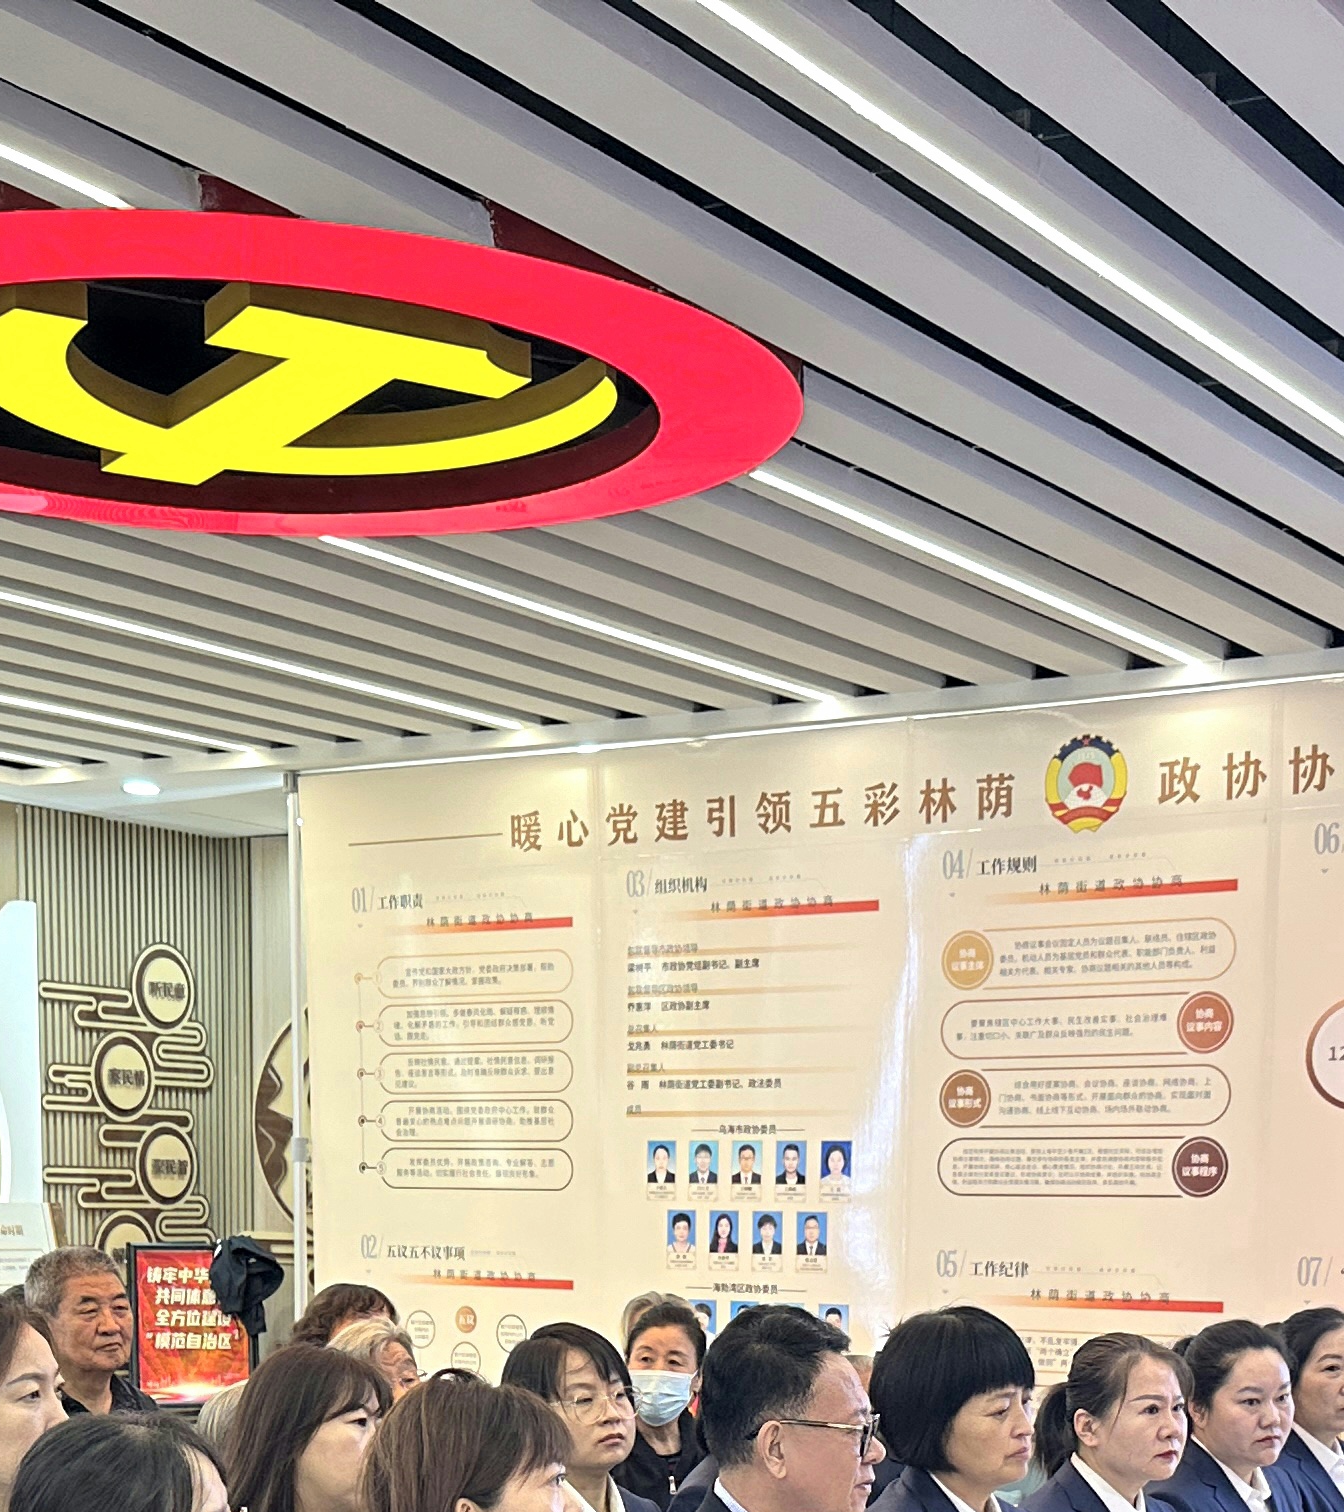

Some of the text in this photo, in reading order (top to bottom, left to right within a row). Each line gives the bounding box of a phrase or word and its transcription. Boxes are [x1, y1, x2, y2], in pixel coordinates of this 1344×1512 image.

[508, 771, 1019, 853] 暖心党建引领五彩林荫
[976, 855, 1038, 876] 工作规则
[654, 876, 708, 895] 组织机构
[1039, 874, 1183, 896] 林荫街道政协协商
[377, 893, 423, 911] 工作职责
[710, 894, 834, 913] 林荫街道政协协商
[426, 912, 534, 928] 林荫街道政协协商
[146, 1266, 210, 1285] 铸牢中华
[432, 1269, 536, 1281] 林荫街道政协协商
[972, 1260, 1029, 1279] 工作纪律
[1030, 1287, 1170, 1305] 林荫街道政协协商
